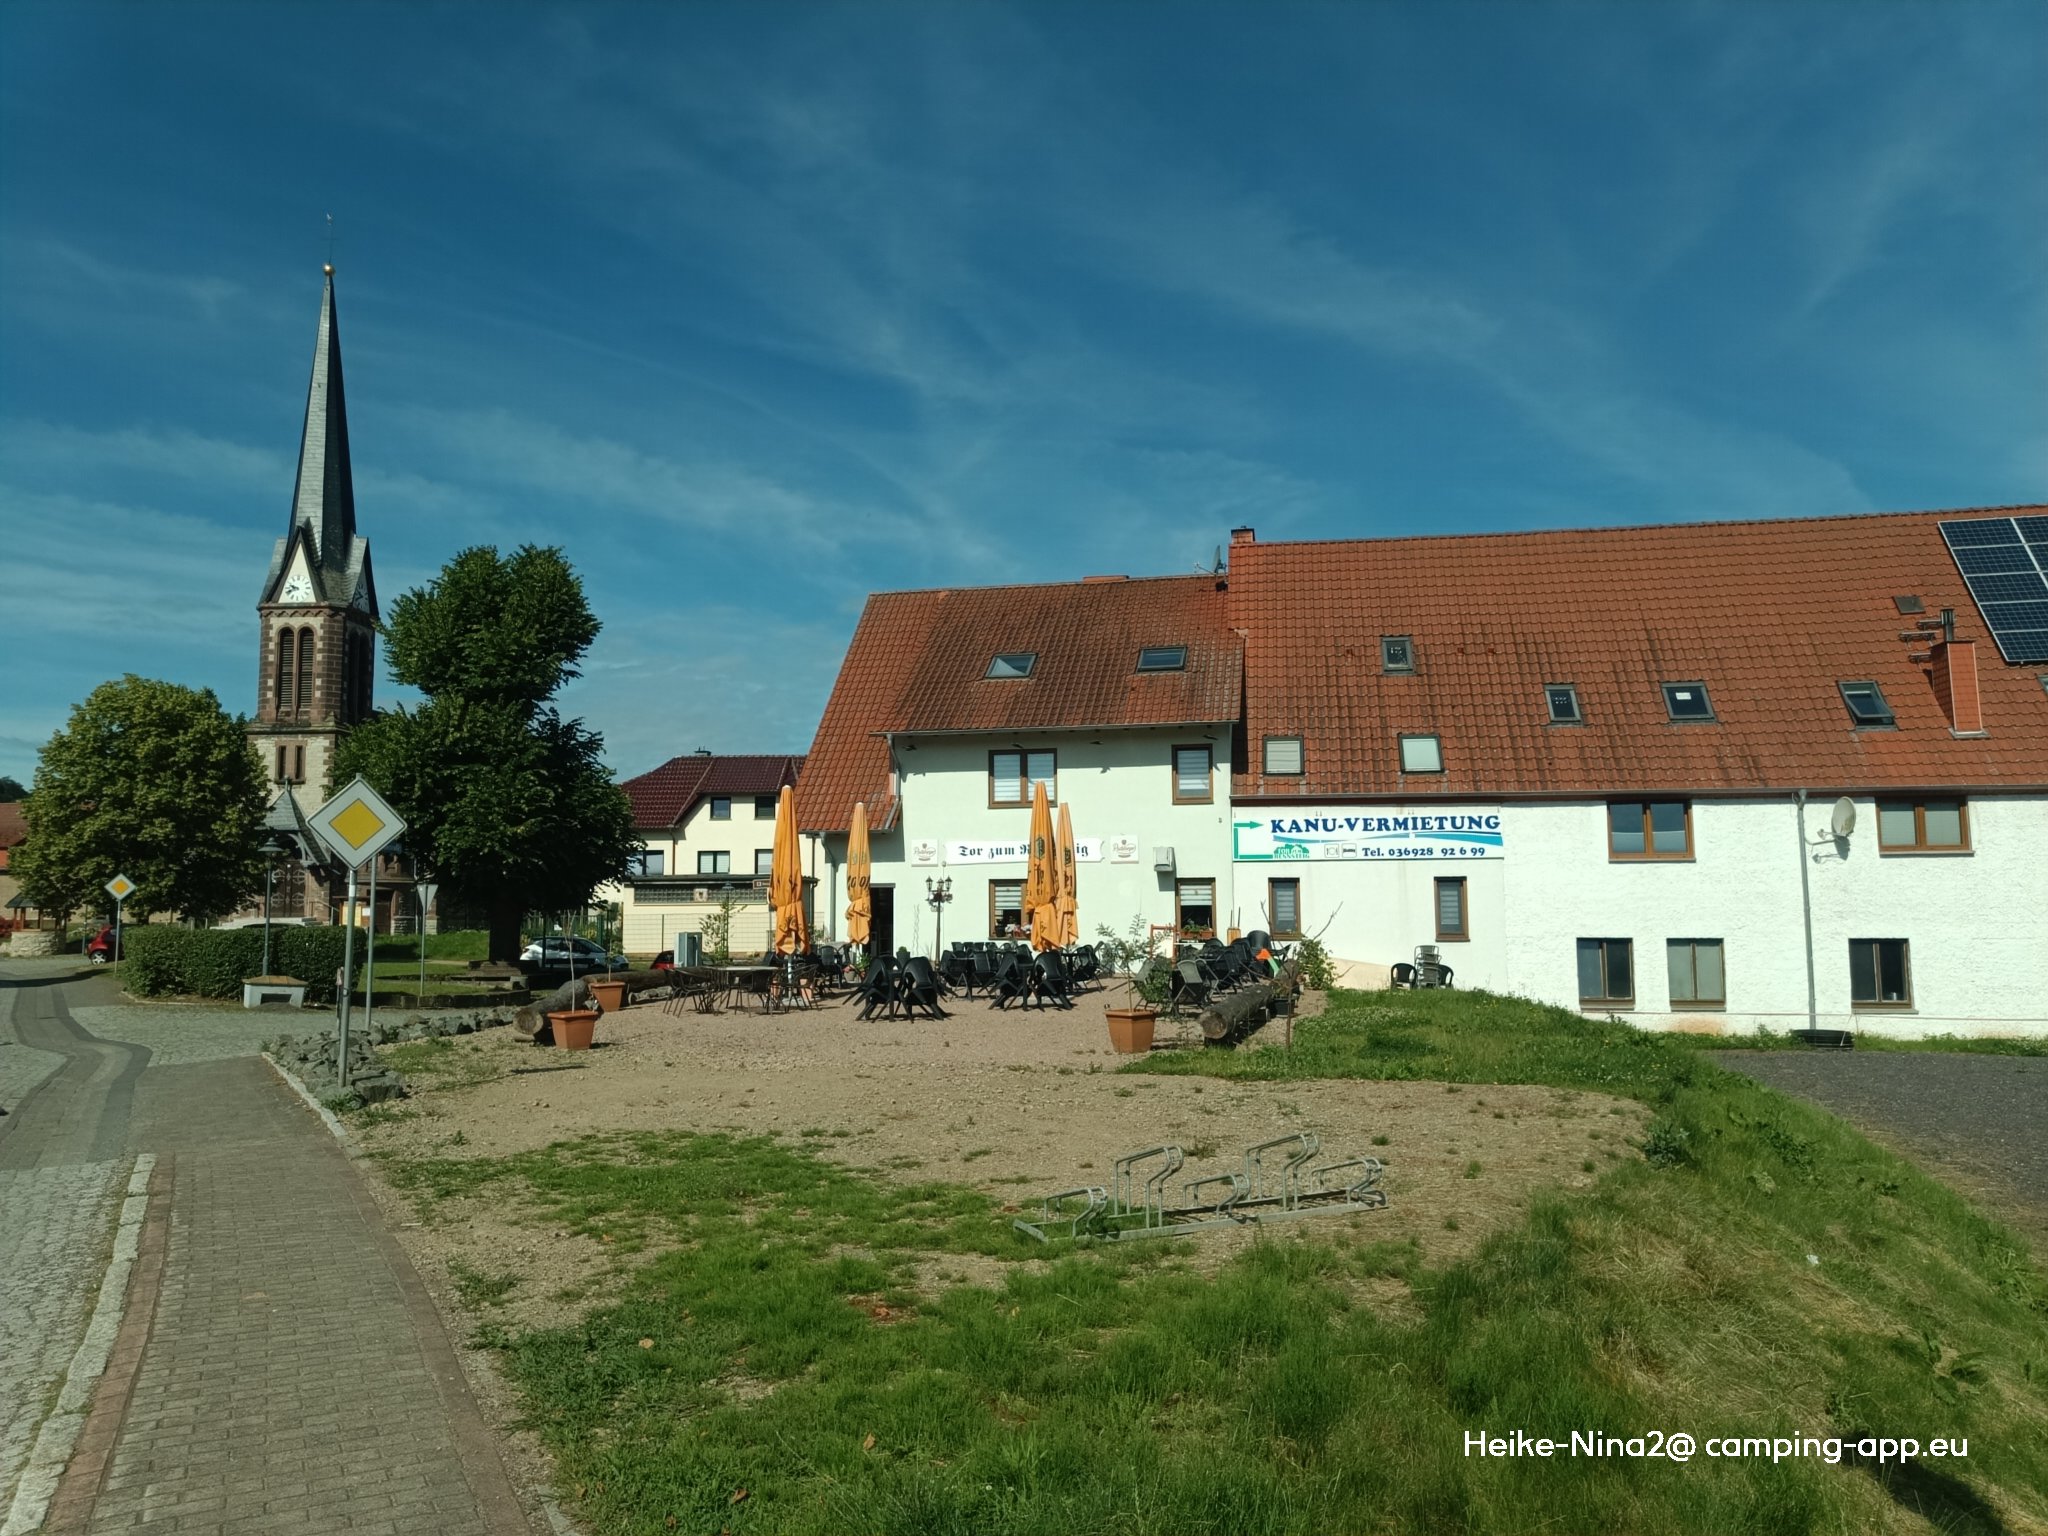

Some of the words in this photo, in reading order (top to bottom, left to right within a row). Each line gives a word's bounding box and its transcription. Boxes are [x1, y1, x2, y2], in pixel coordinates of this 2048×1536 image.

[1271, 815, 1500, 833] KANU-VERMIETUNG
[958, 845, 983, 857] Tor
[988, 846, 1015, 859] zum
[1362, 847, 1385, 857] Tel.
[1388, 847, 1433, 857] 036928
[1441, 847, 1455, 857] 92
[1459, 847, 1467, 856] 6
[1470, 847, 1486, 857] 99
